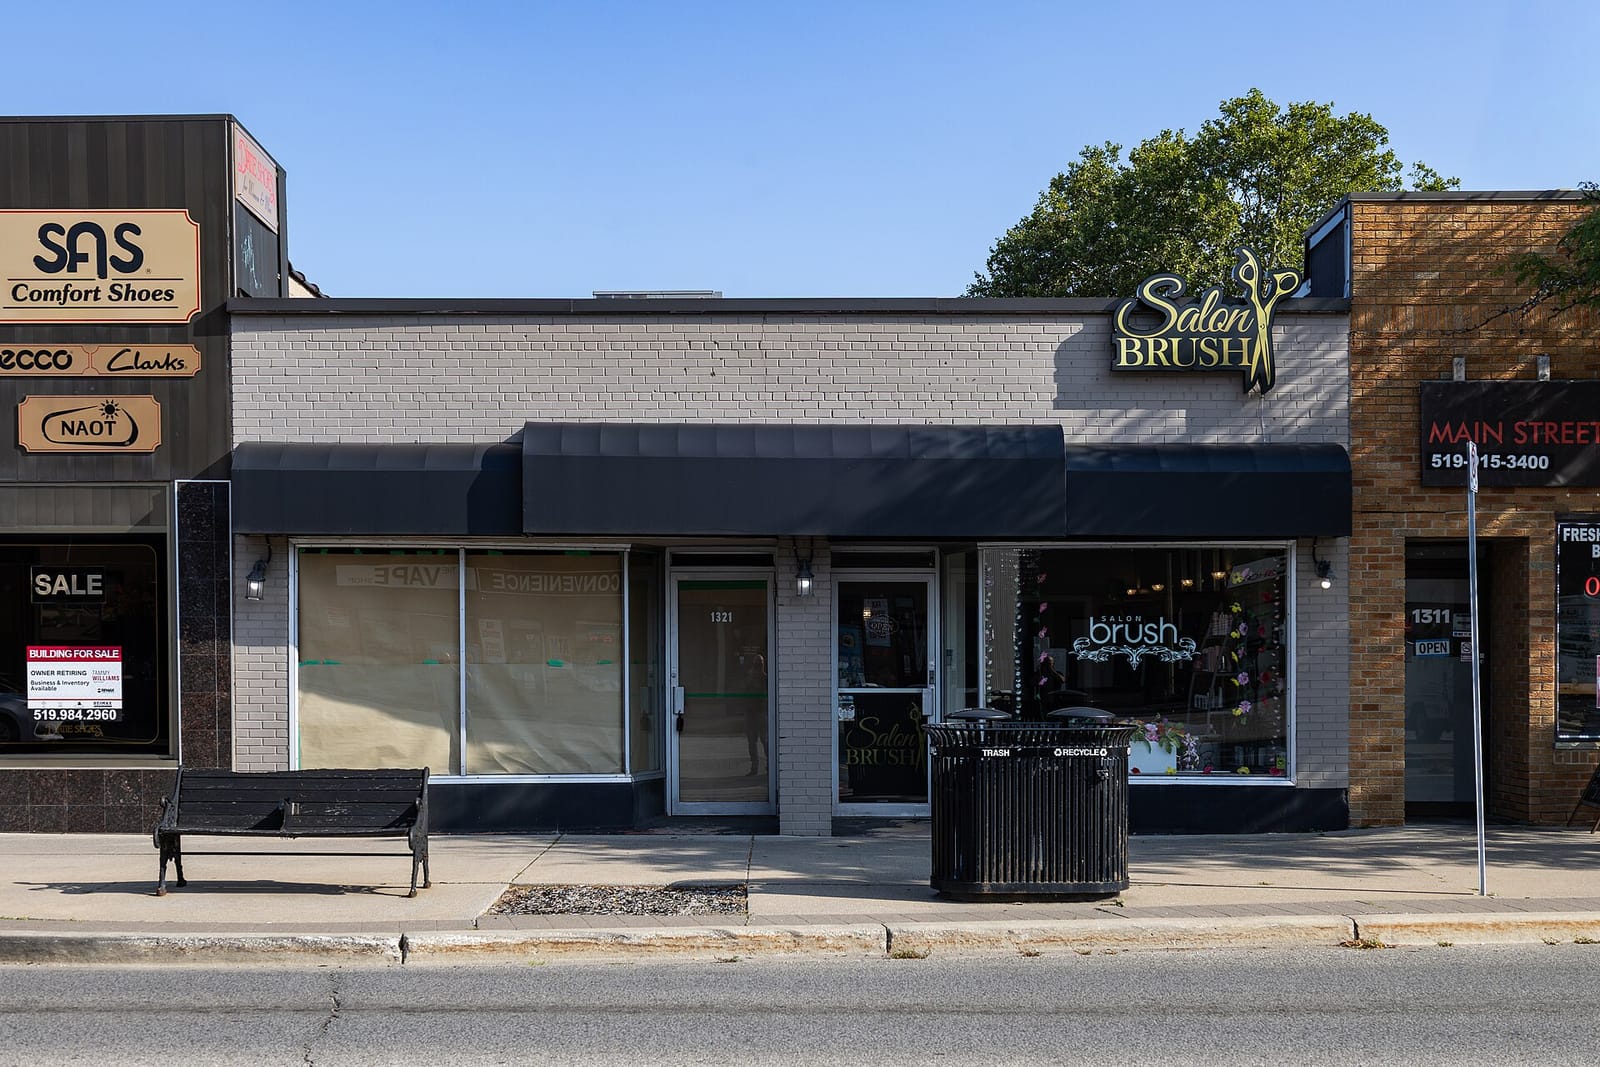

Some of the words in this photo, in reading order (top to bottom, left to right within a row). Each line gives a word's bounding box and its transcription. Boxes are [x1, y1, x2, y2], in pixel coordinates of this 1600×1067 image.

[33, 221, 144, 279] SAS
[11, 283, 102, 305] Comfort
[107, 283, 175, 302] Shoes
[1117, 277, 1255, 338] Salon
[107, 348, 185, 371] Clarks
[1116, 337, 1252, 367] BRUSH
[60, 420, 116, 436] NAOT
[1428, 420, 1503, 444] MAIN
[1513, 420, 1600, 445] STREET
[1431, 454, 1549, 470] 519-15-3400
[34, 574, 103, 595] SALE
[710, 611, 733, 623] 1321
[1412, 608, 1450, 624] 1311
[1089, 616, 1178, 644] brush
[29, 649, 72, 658] BUILDING
[73, 649, 93, 658] FOR
[94, 649, 119, 658] SALE
[1419, 642, 1447, 654] OPEN
[33, 709, 117, 720] 519.984.2960
[846, 716, 916, 749] Salon
[846, 749, 916, 766] BRUSH
[981, 749, 1010, 757] TRASH
[1062, 748, 1100, 756] RECYCLE
